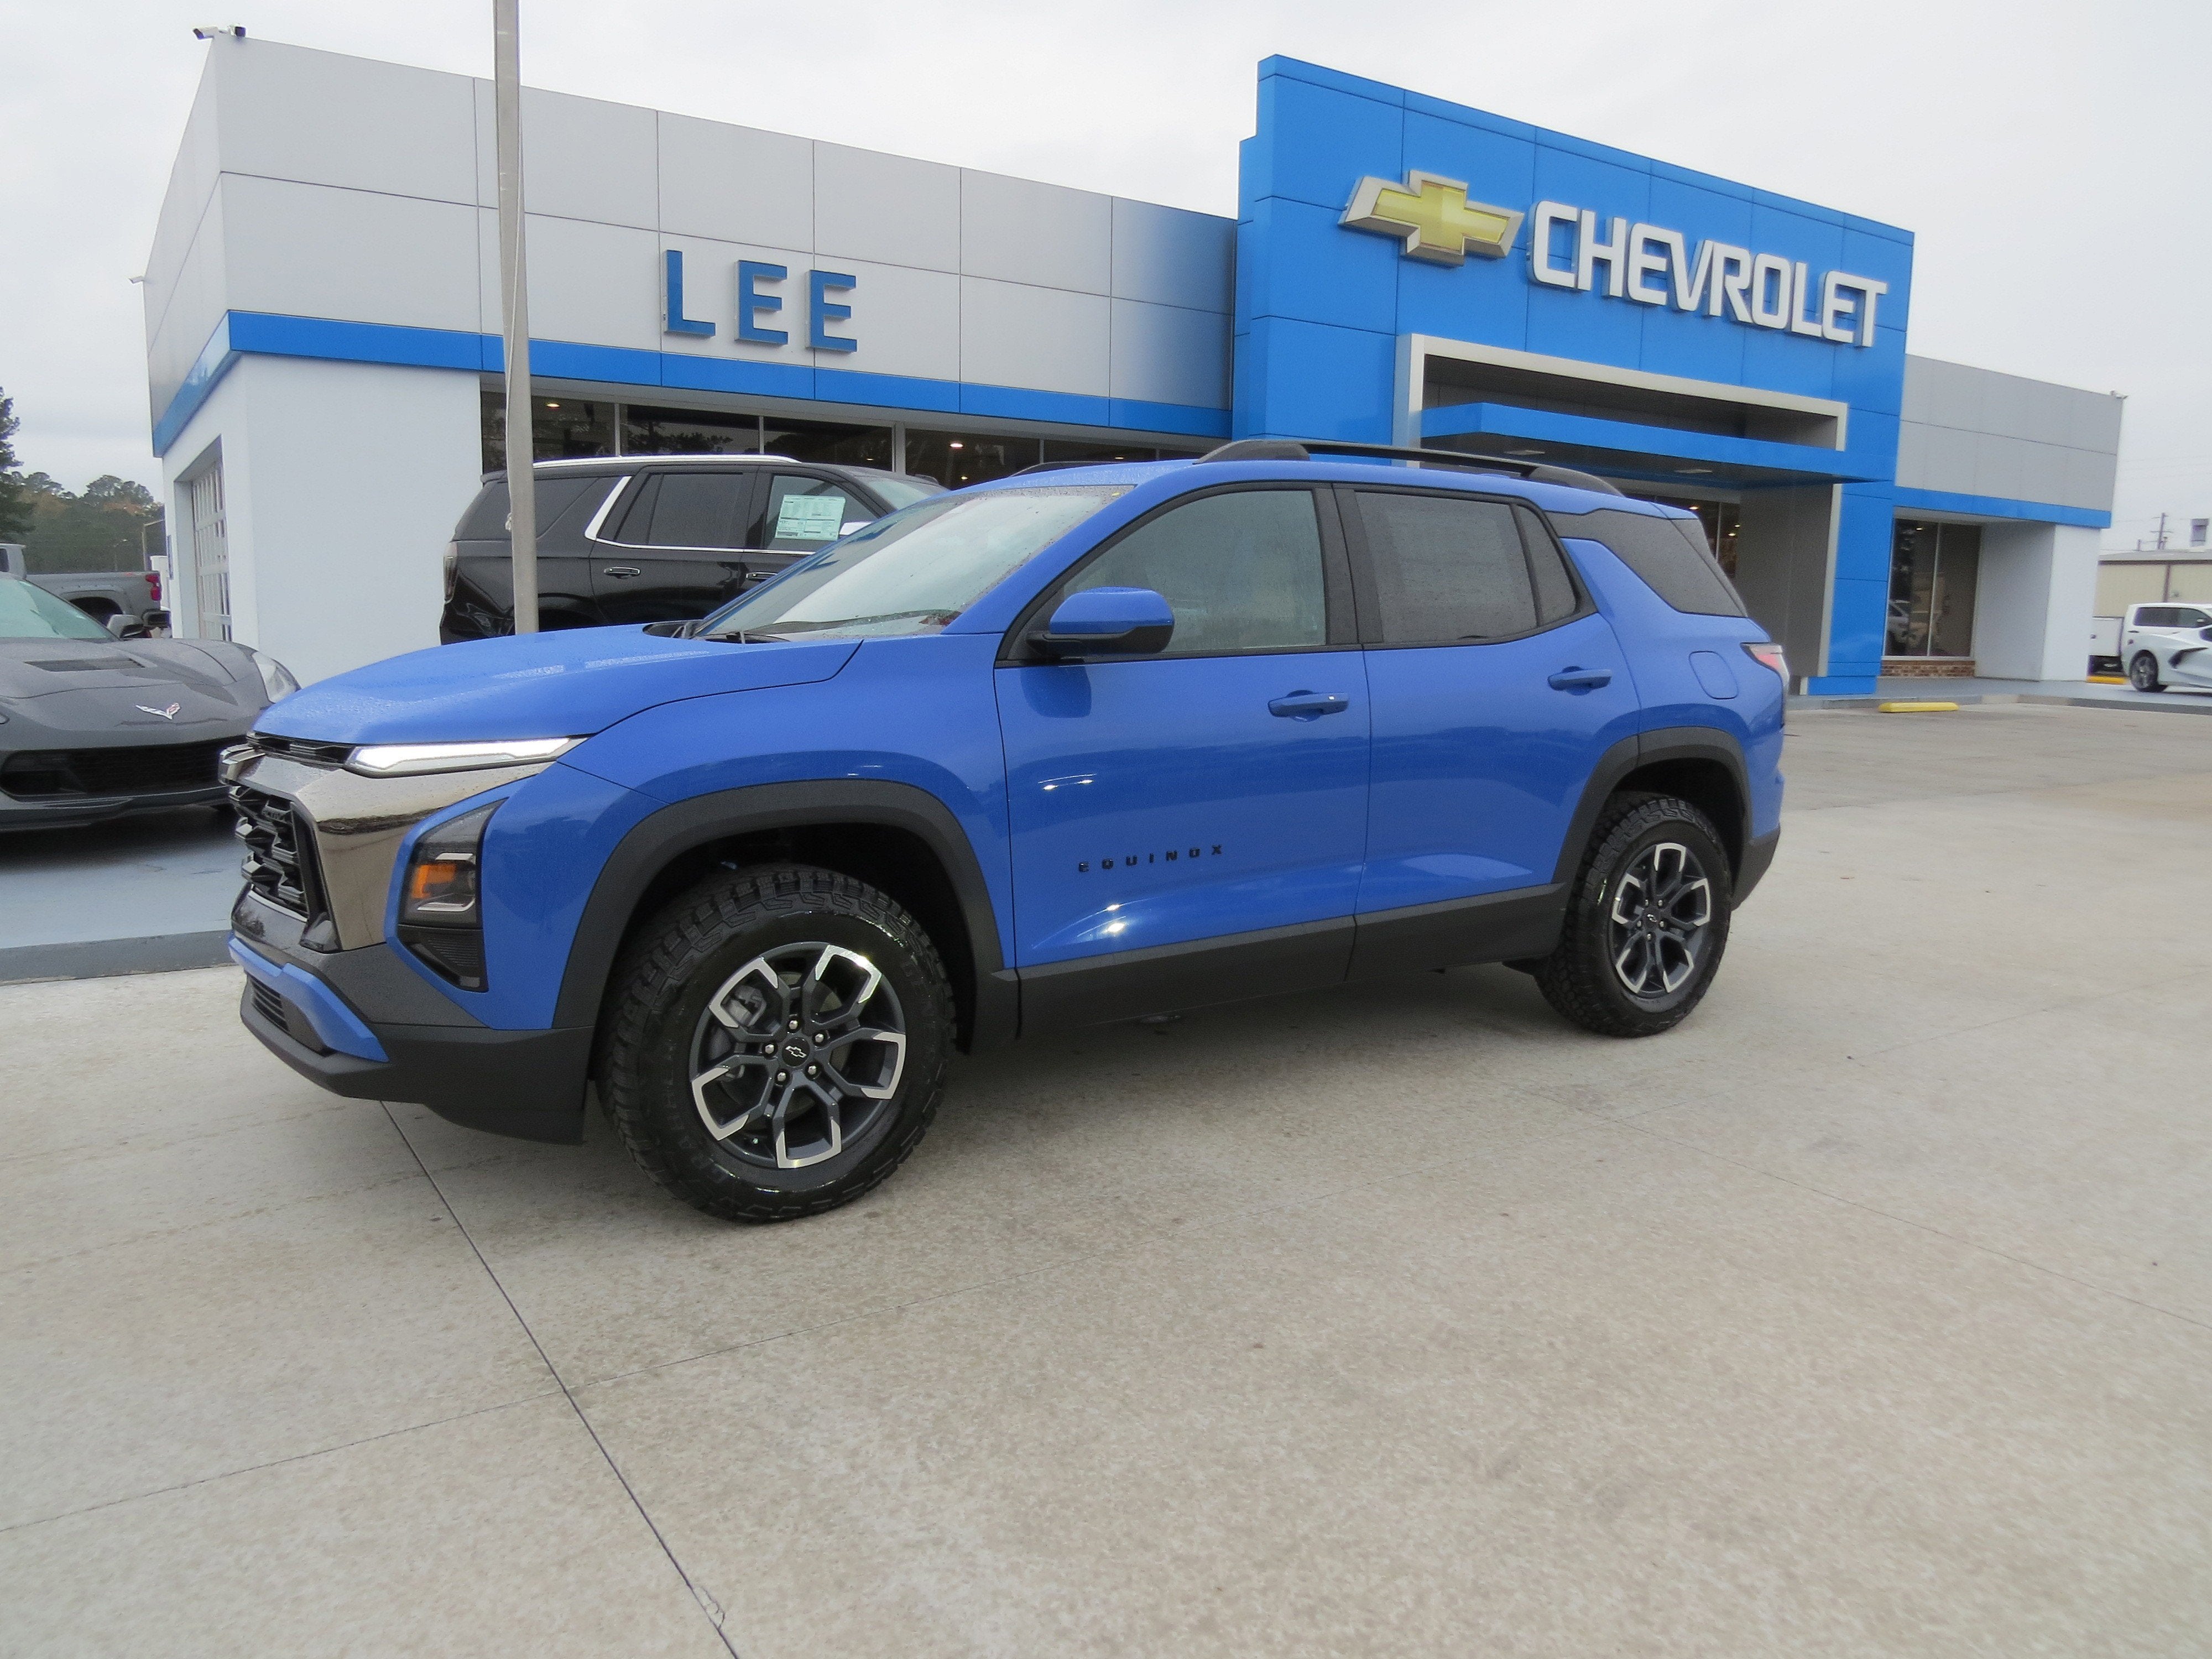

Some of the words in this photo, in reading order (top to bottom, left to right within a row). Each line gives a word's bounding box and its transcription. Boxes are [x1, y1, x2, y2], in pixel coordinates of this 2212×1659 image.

[665, 249, 858, 352] LEE
[1528, 200, 1887, 348] CHEVROLET
[1078, 844, 1223, 873] EQUINOX
